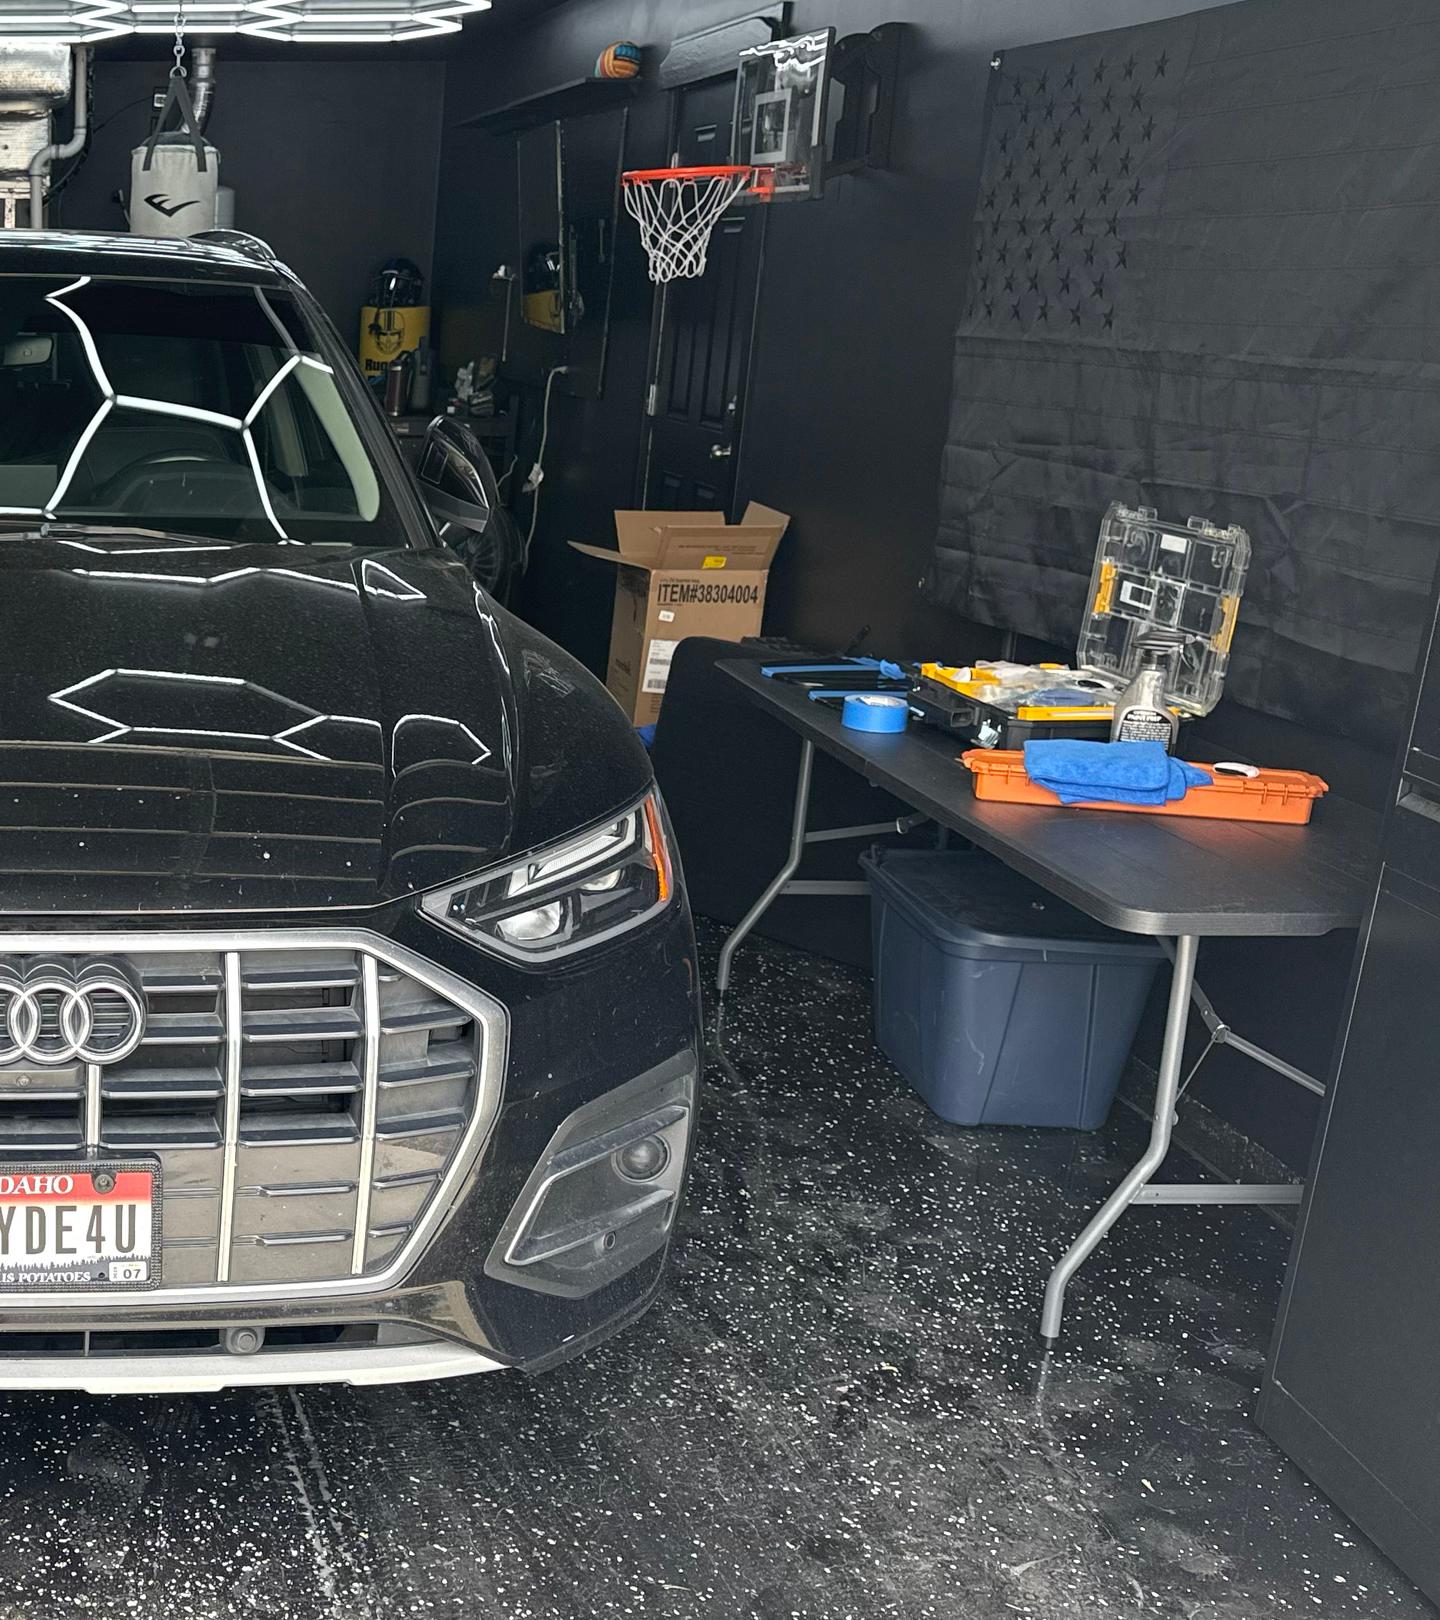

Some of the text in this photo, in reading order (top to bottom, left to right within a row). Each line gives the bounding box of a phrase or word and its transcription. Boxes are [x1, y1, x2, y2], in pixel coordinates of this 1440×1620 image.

[657, 583, 759, 605] ITEM#38304004
[18, 1270, 92, 1284] POTATOES
[123, 1268, 142, 1280] 07
